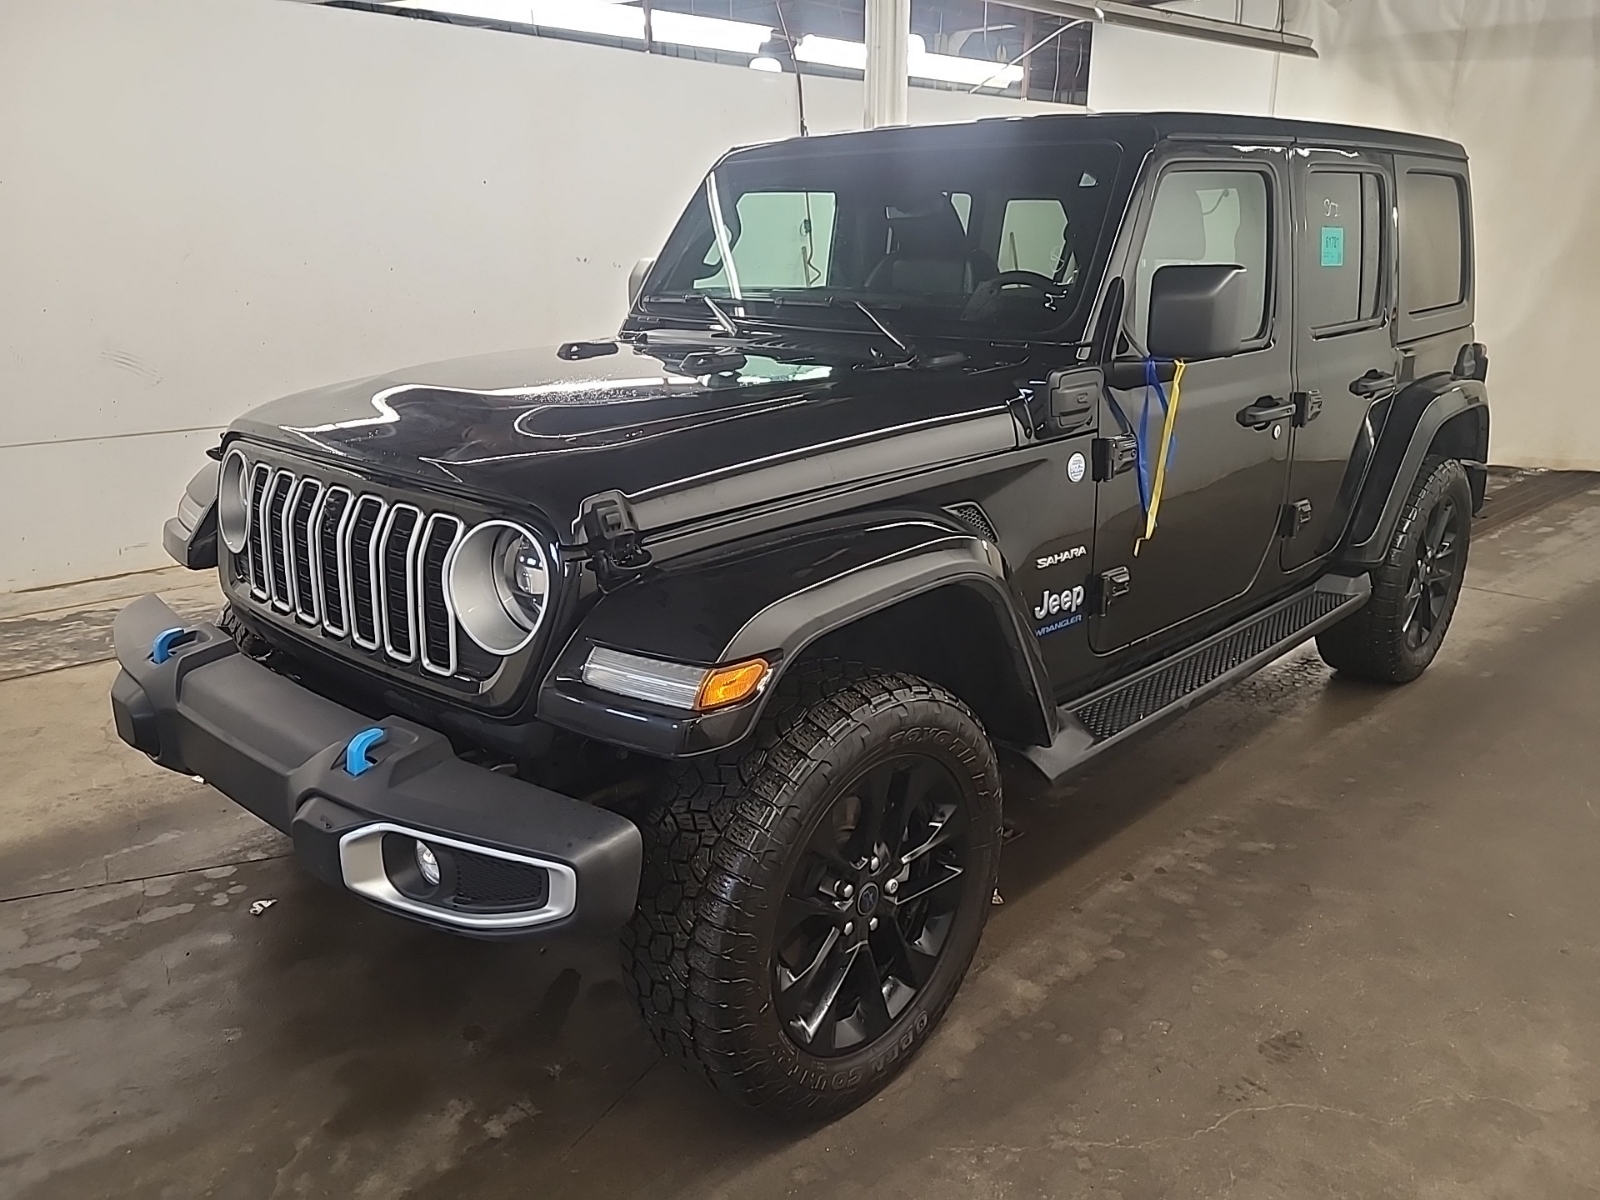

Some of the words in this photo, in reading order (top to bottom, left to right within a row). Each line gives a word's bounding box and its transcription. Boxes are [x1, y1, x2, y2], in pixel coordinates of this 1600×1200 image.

[1036, 545, 1087, 569] SAHARA
[1034, 585, 1085, 619] Jeep
[1035, 614, 1082, 637] WRANGLER
